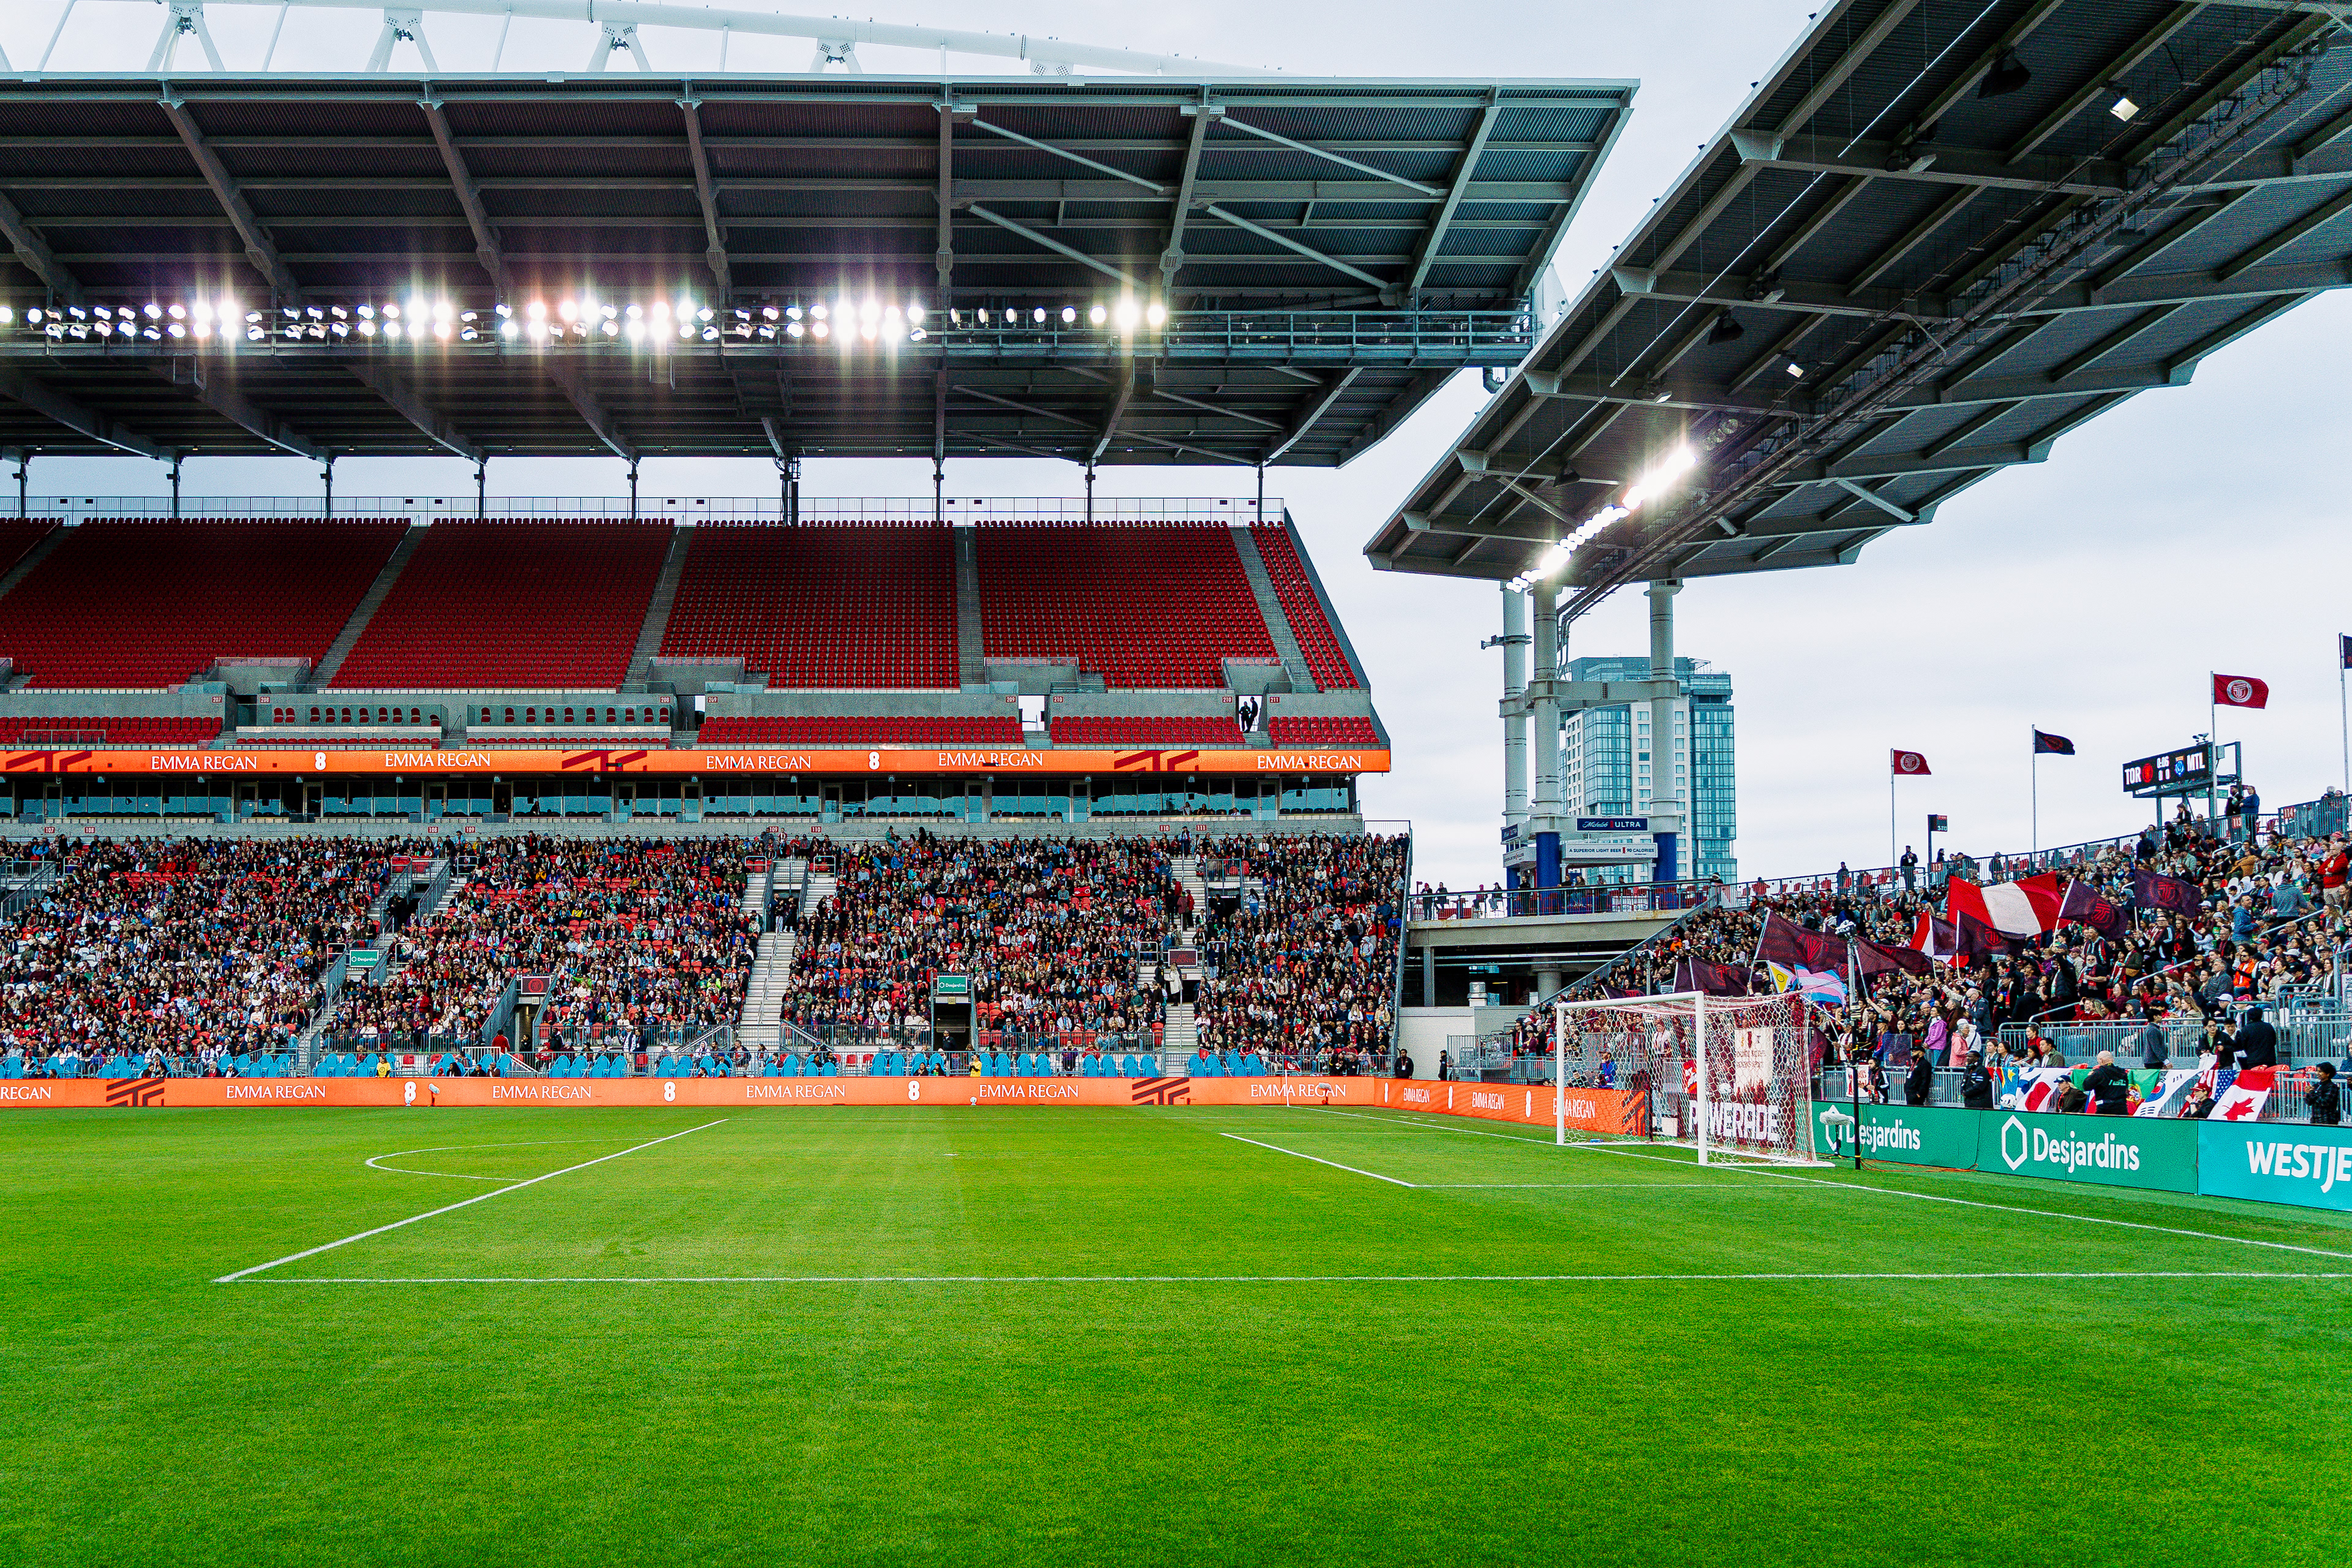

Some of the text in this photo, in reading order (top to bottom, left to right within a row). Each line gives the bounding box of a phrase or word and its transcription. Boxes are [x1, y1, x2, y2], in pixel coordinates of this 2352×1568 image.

[151, 755, 257, 770] EMMA REGAN
[315, 752, 326, 771] 8
[385, 753, 491, 767] EMMA REGAN
[706, 755, 812, 769] EMMA REGAN
[869, 751, 880, 771] 8
[938, 752, 1043, 767] EMMA REGAN
[1257, 755, 1362, 769] EMMA REGAN
[2187, 752, 2205, 772] MTL
[2124, 766, 2142, 785] TOR
[2284, 807, 2294, 818] 114
[1882, 869, 1891, 877] 112
[0, 1086, 51, 1100] REGAN
[226, 1085, 326, 1099] EMMA REGAN
[404, 1081, 417, 1102] 8
[492, 1085, 592, 1099] EMMA REGAN
[663, 1081, 676, 1102] 8
[746, 1084, 845, 1098] EMMA REGAN
[908, 1080, 920, 1101] 8
[979, 1084, 1079, 1098] EMMA REGAN
[1250, 1084, 1346, 1098] EMMA REGAN
[1384, 1082, 1389, 1103] 8
[1403, 1087, 1430, 1103] EMMA REGAN
[1448, 1085, 1453, 1109] 8
[1472, 1091, 1505, 1110] EMMA REGAN
[1525, 1090, 1531, 1118] 8
[1553, 1098, 1596, 1119] EMA REGAN
[1689, 1100, 1780, 1142] PWERADE
[1846, 1115, 1921, 1153] Desjardins
[2033, 1128, 2140, 1173] Desjardins
[2246, 1140, 2352, 1193] WESTJE
